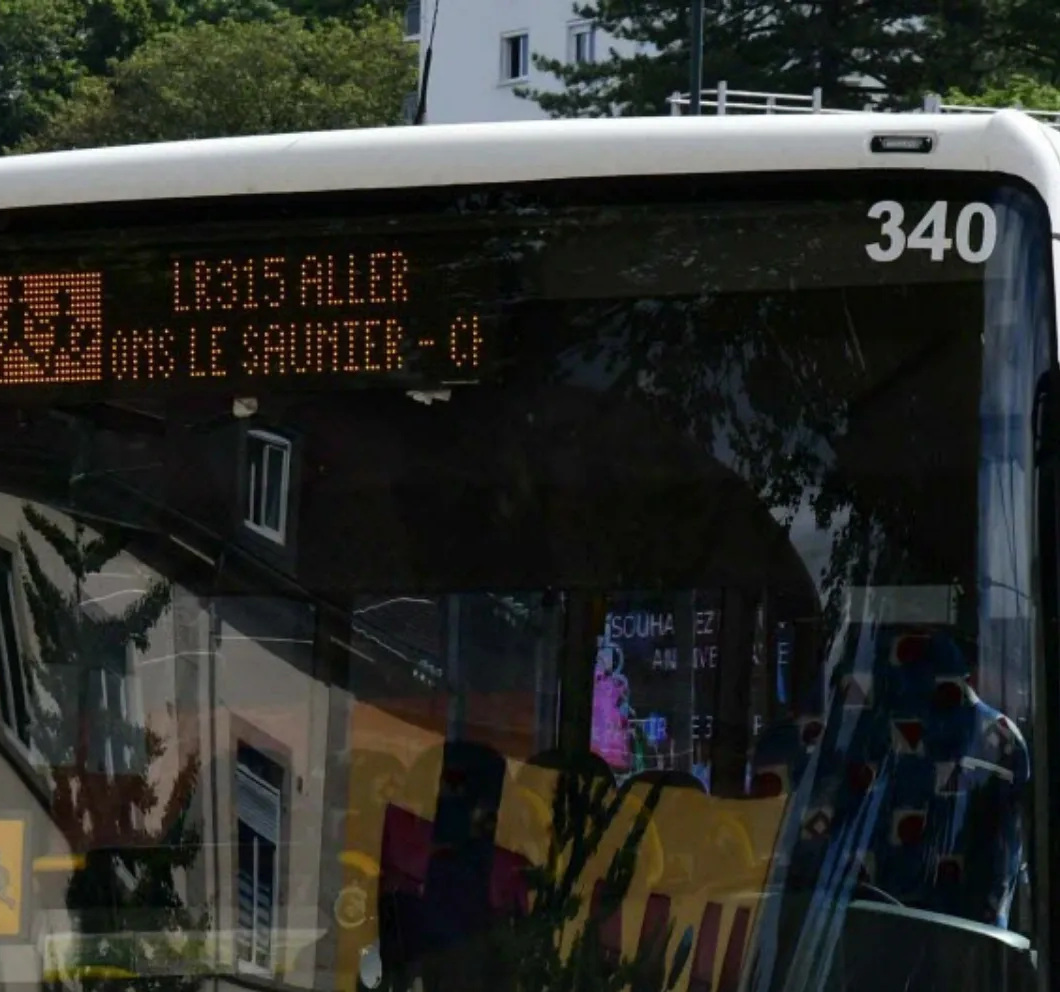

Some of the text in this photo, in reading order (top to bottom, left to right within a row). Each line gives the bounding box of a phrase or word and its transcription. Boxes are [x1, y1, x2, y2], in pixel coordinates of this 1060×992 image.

[864, 199, 998, 264] 340
[173, 251, 408, 312] LR315 ALLER
[189, 326, 227, 378] LE
[241, 318, 404, 376] SAUNIER
